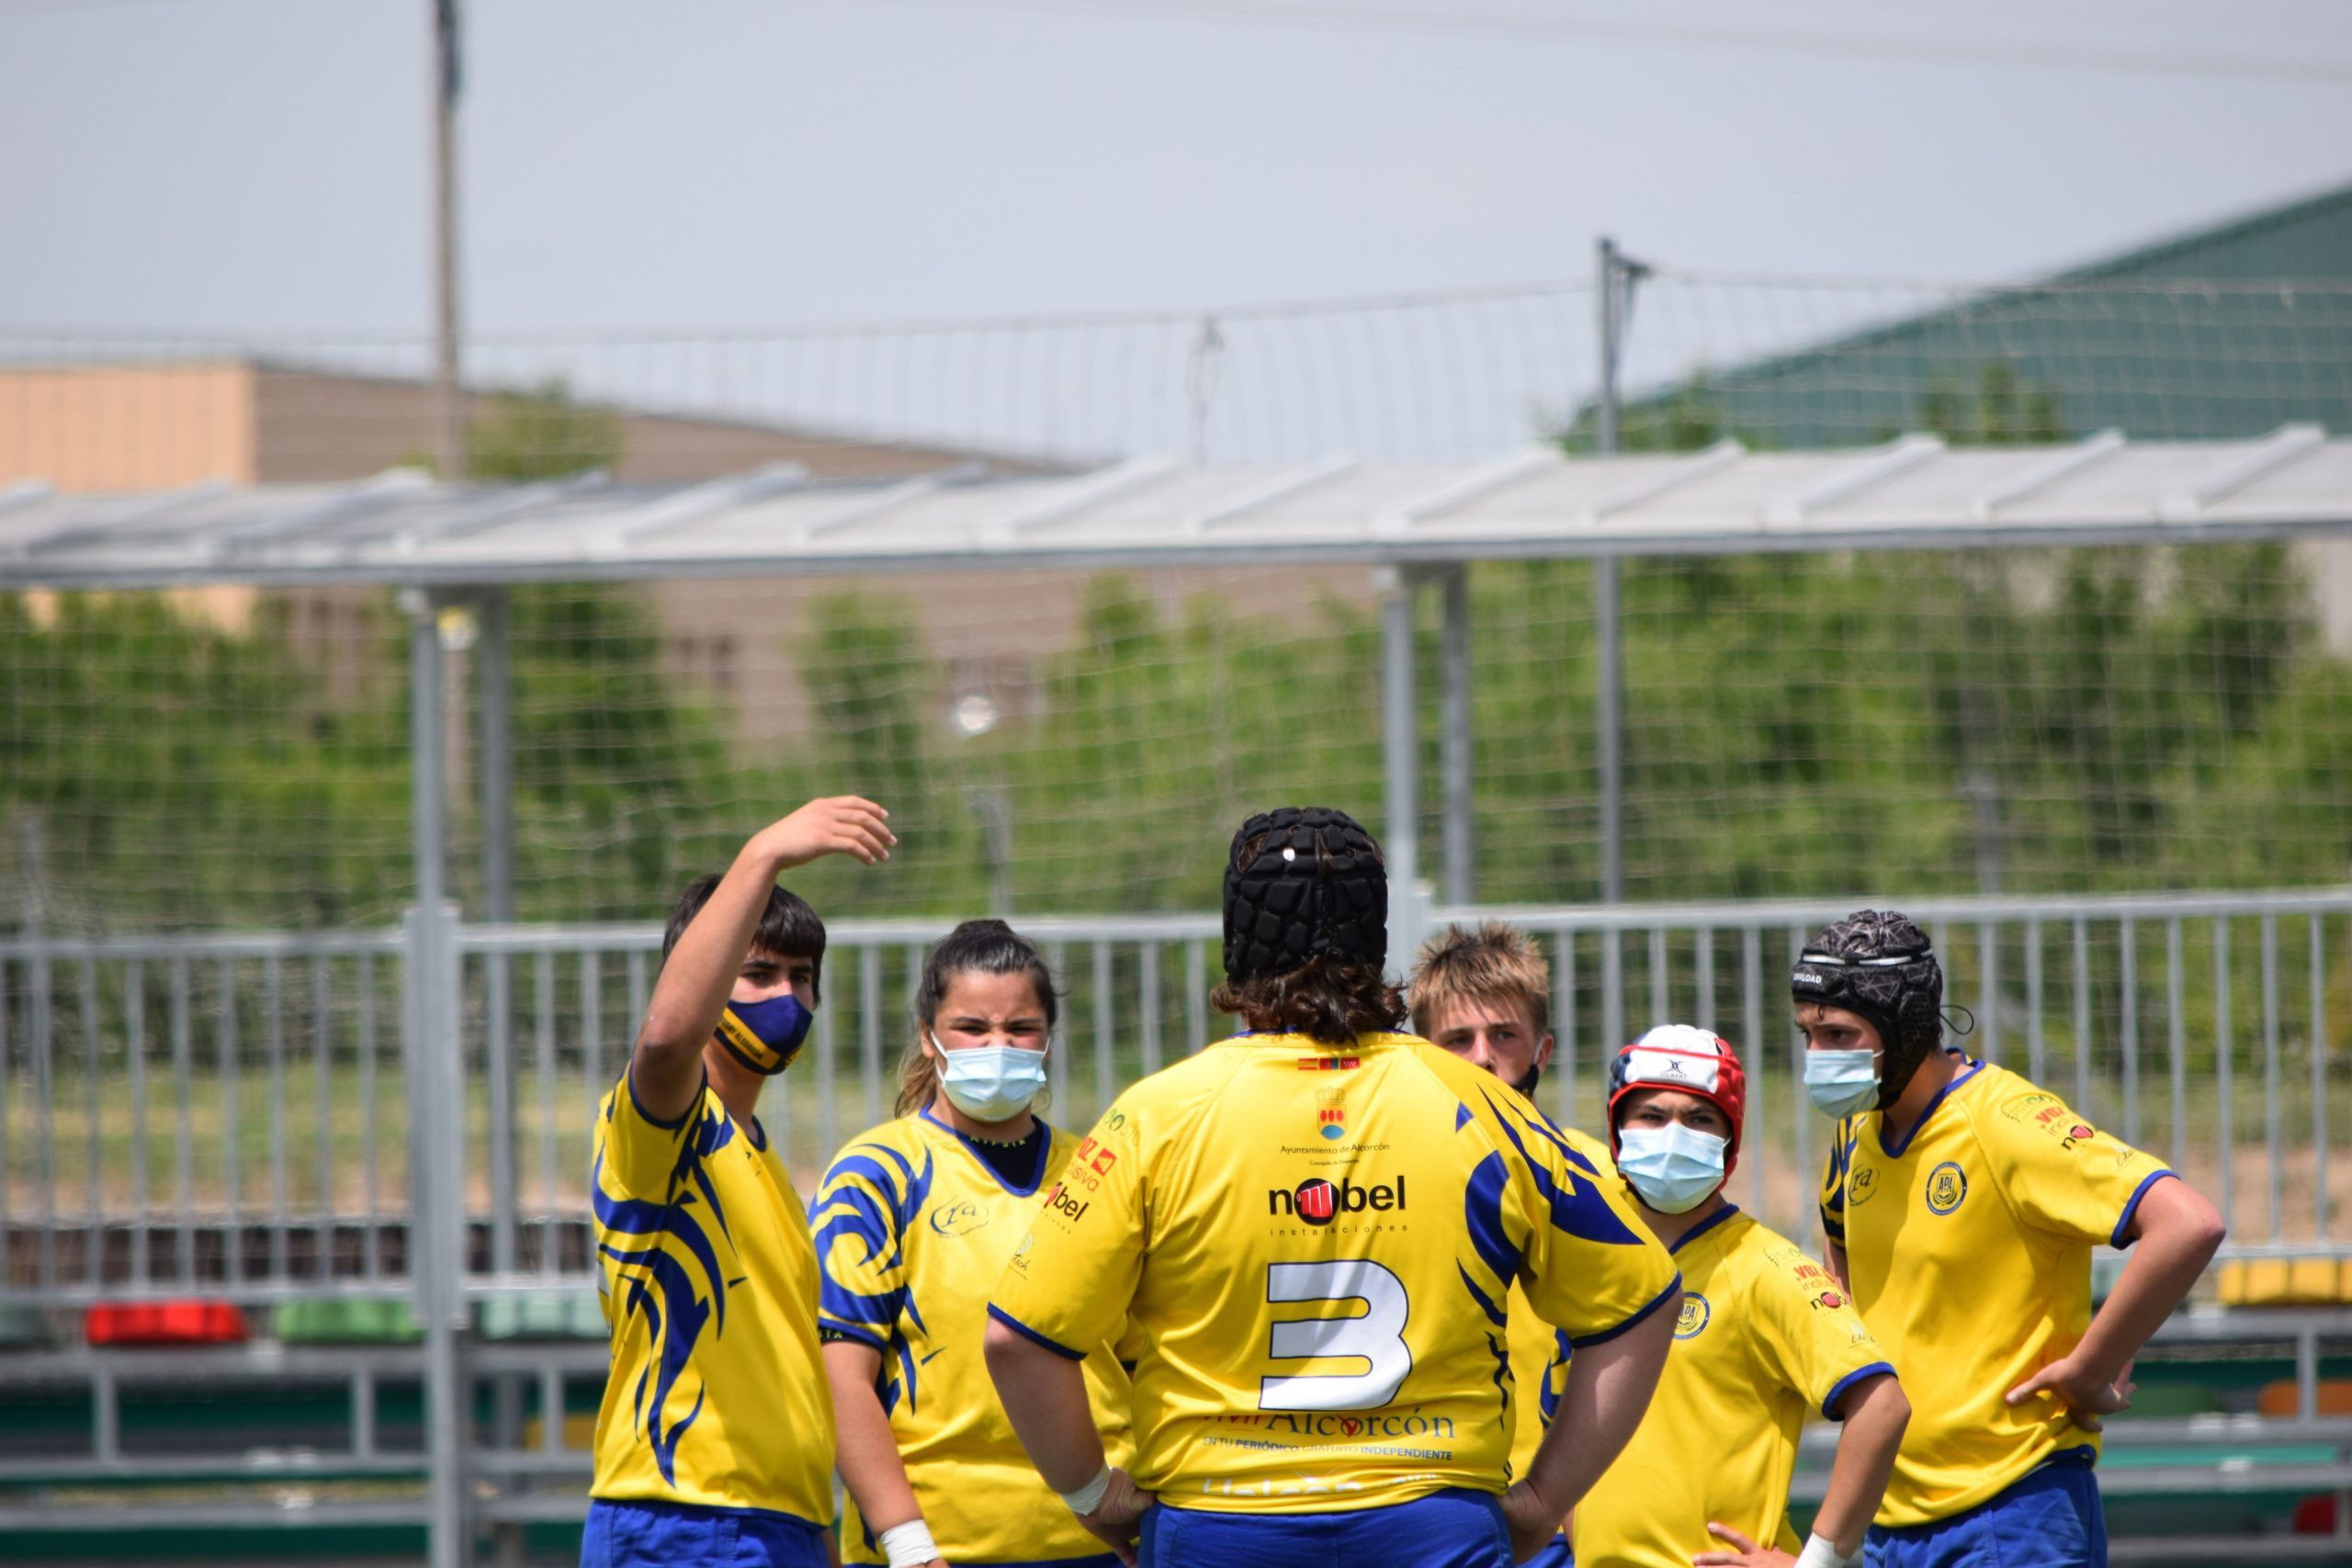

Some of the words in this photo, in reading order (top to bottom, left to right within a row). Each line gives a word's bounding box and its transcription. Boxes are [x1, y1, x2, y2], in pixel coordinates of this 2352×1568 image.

[1280, 1145, 1338, 1156] Ayuntamiento
[1340, 1145, 1350, 1154] de
[1351, 1143, 1389, 1153] Alcorcón
[1268, 1175, 1406, 1227] nobel
[1270, 1224, 1408, 1236] instalaciones
[1258, 1258, 1413, 1411] 3
[1266, 1407, 1455, 1438] Alcorcón
[1203, 1436, 1216, 1447] EN
[1219, 1438, 1234, 1448] TU
[1236, 1438, 1299, 1452] PERIÓDICO
[1361, 1446, 1453, 1461] INDEPENDIENTE
